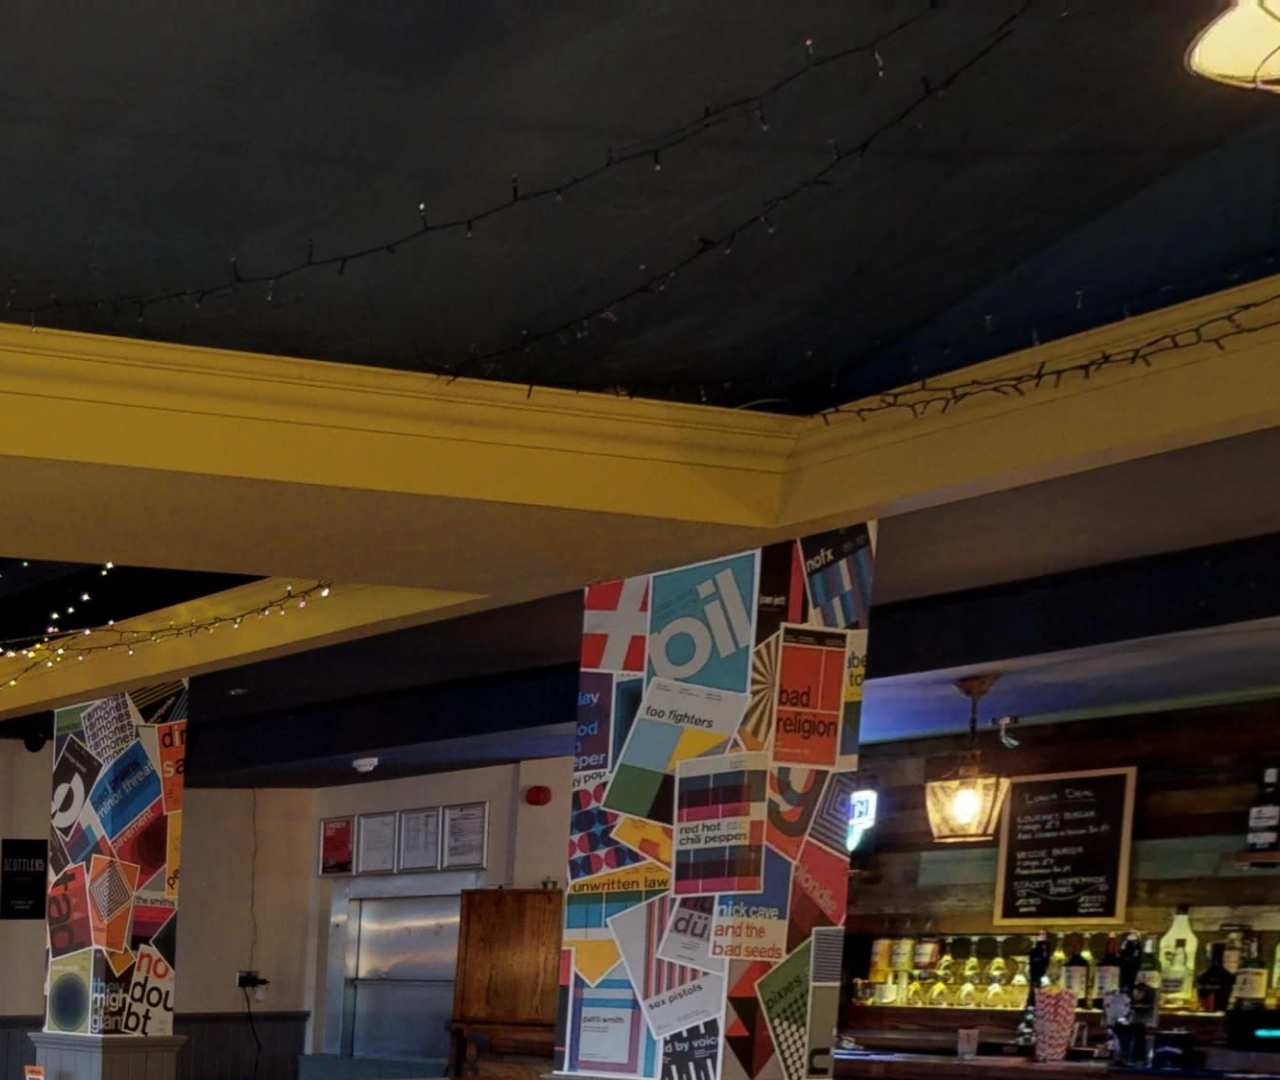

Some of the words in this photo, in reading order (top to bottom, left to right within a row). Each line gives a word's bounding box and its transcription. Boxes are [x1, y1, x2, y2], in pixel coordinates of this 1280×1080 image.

[778, 684, 811, 707] bad
[645, 705, 665, 719] foo
[668, 709, 713, 728] fighters
[775, 714, 838, 740] religion
[679, 823, 699, 834] red
[702, 822, 721, 832] hot
[572, 878, 639, 892] unwritten
[644, 876, 670, 888] law
[718, 899, 746, 917] nick
[714, 921, 742, 938] and
[746, 922, 766, 938] the
[712, 940, 741, 956] bad
[744, 944, 783, 959] seeds
[137, 952, 170, 979] no
[124, 1003, 151, 1035] bt
